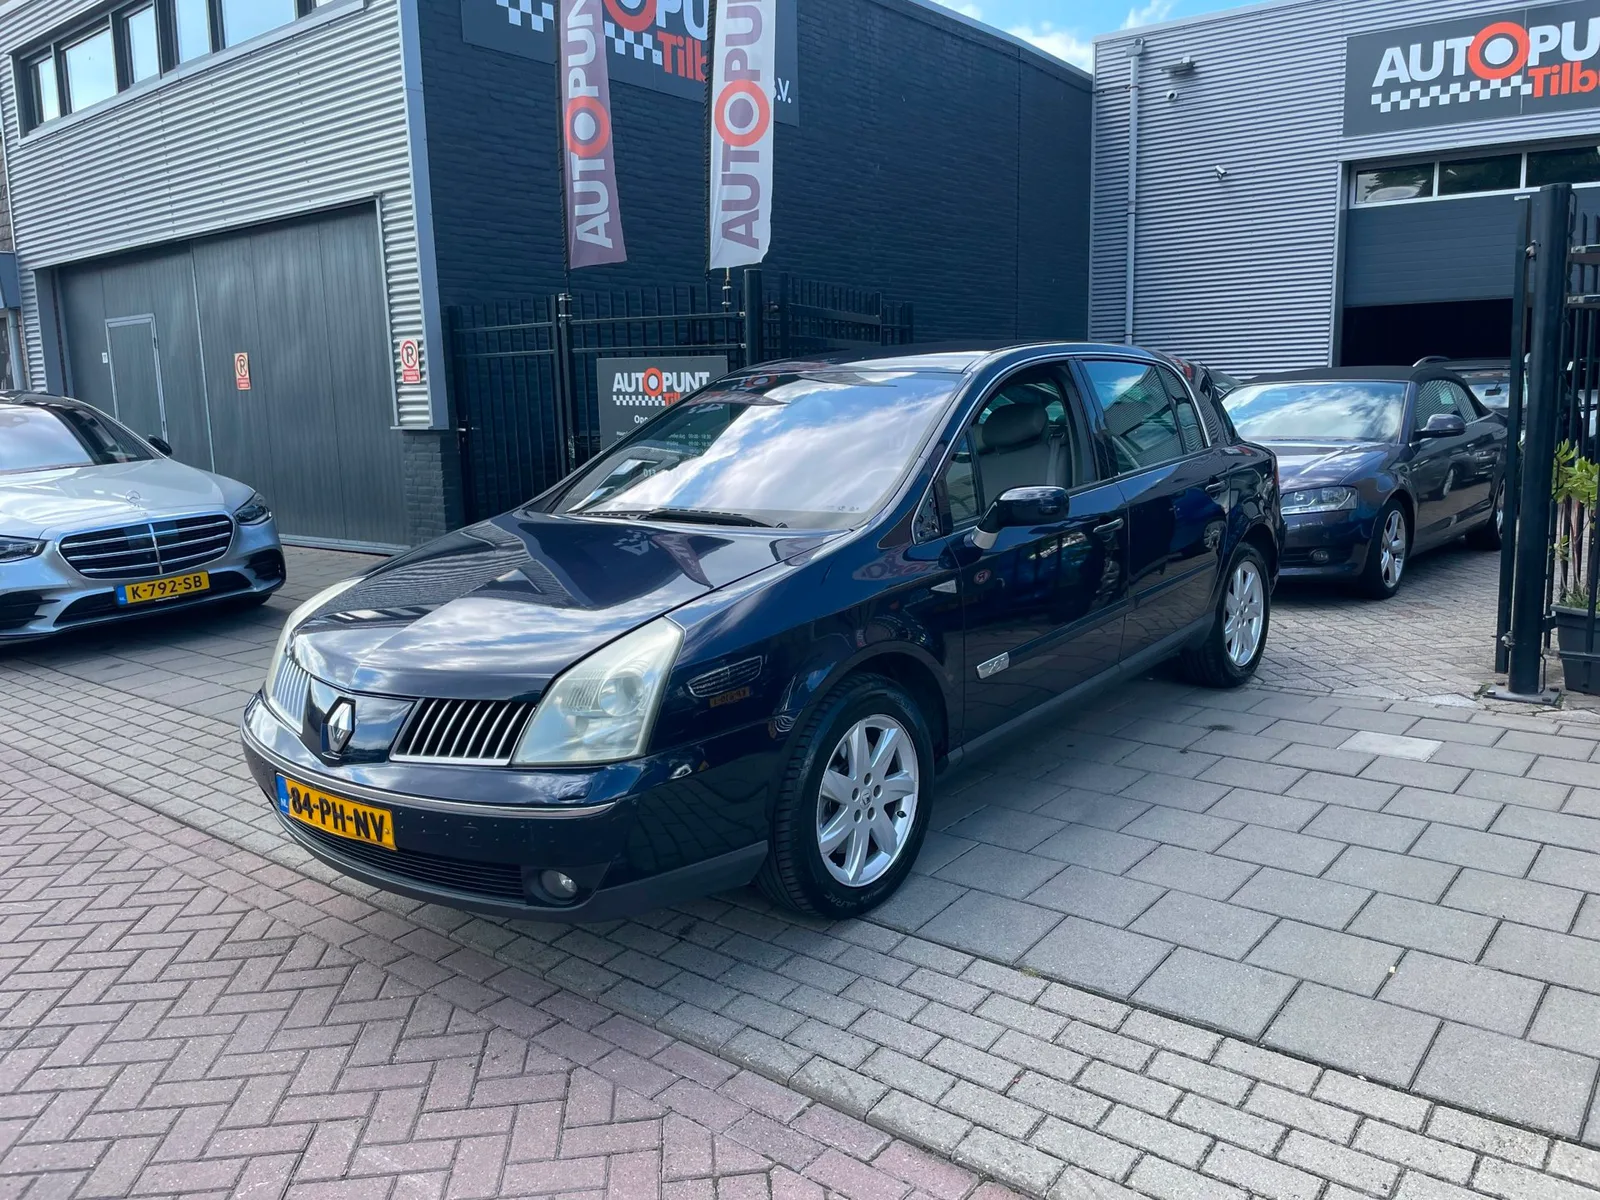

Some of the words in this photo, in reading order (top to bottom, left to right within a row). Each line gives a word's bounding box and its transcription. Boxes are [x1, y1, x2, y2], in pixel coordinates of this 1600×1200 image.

[713, 0, 770, 250] AUTOPU
[612, 367, 710, 396] AUTOPUNT
[131, 575, 203, 600] K-792-SB
[290, 786, 385, 842] 84-PH-NV
